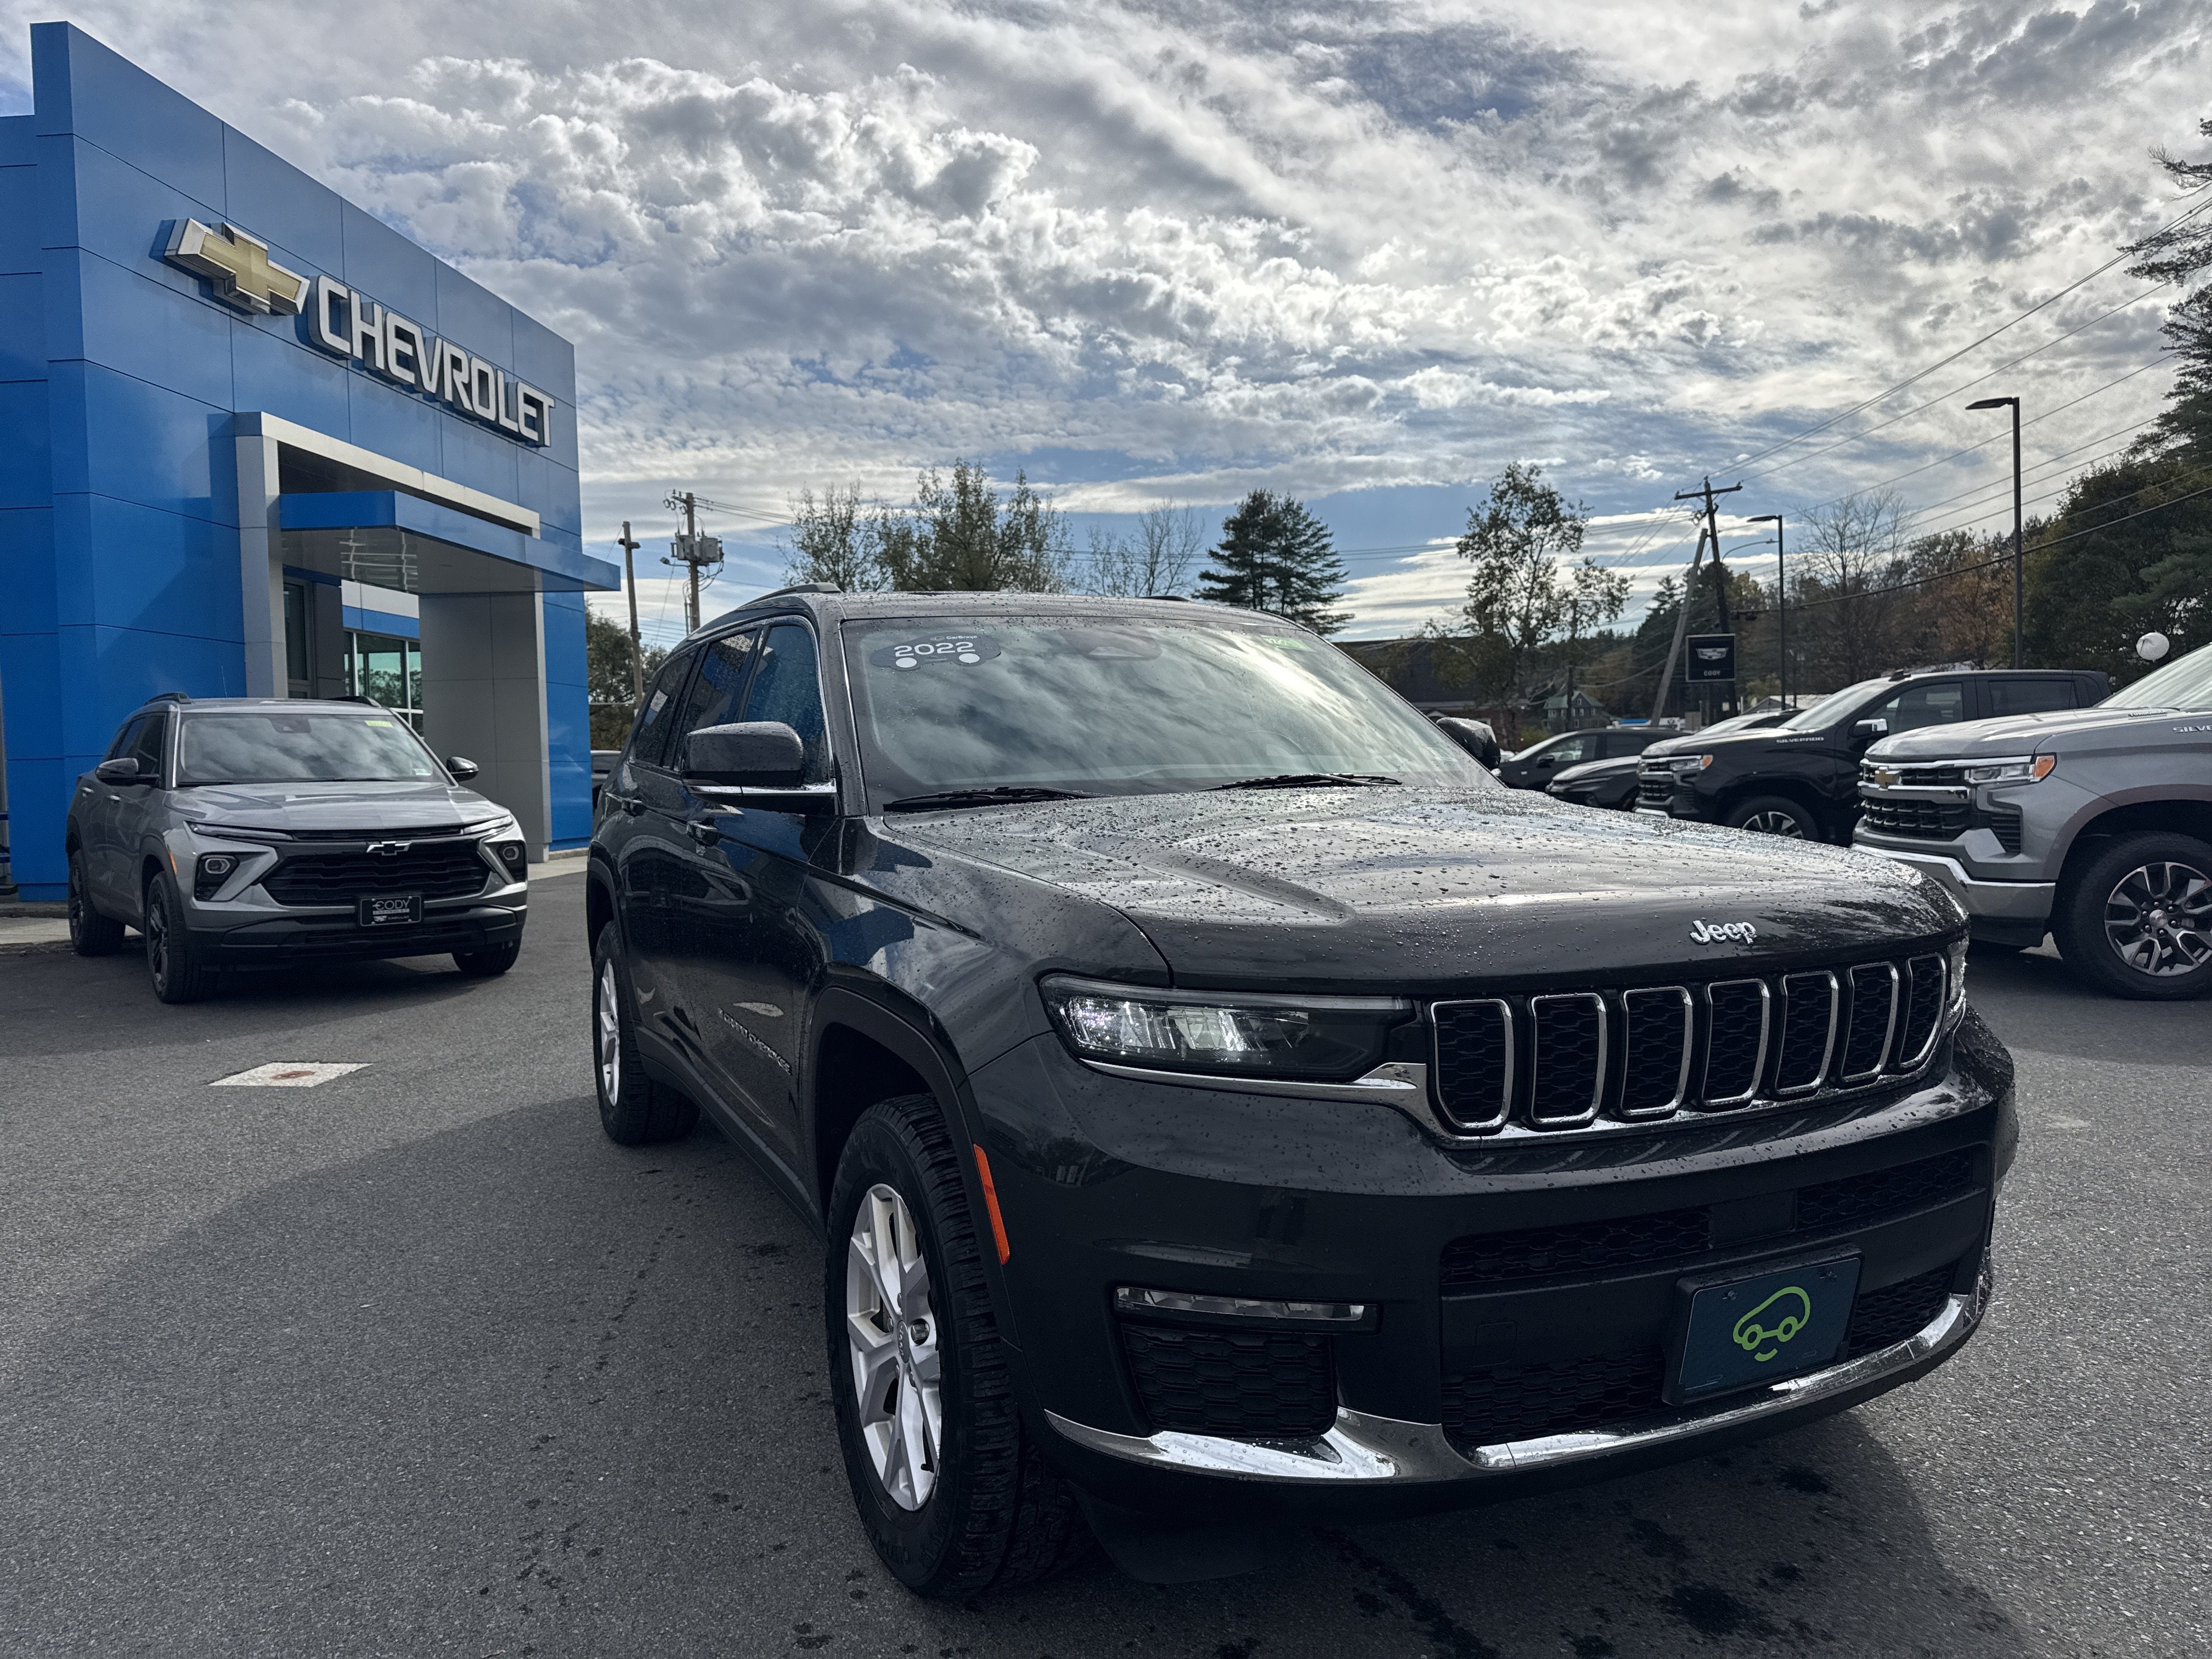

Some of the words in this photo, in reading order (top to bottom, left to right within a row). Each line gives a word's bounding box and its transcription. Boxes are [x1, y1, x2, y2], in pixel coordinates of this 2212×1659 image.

[311, 274, 555, 447] CHEVROLET
[894, 641, 976, 657] 2022
[375, 899, 410, 911] CODY
[1690, 920, 1758, 945] Jeep
